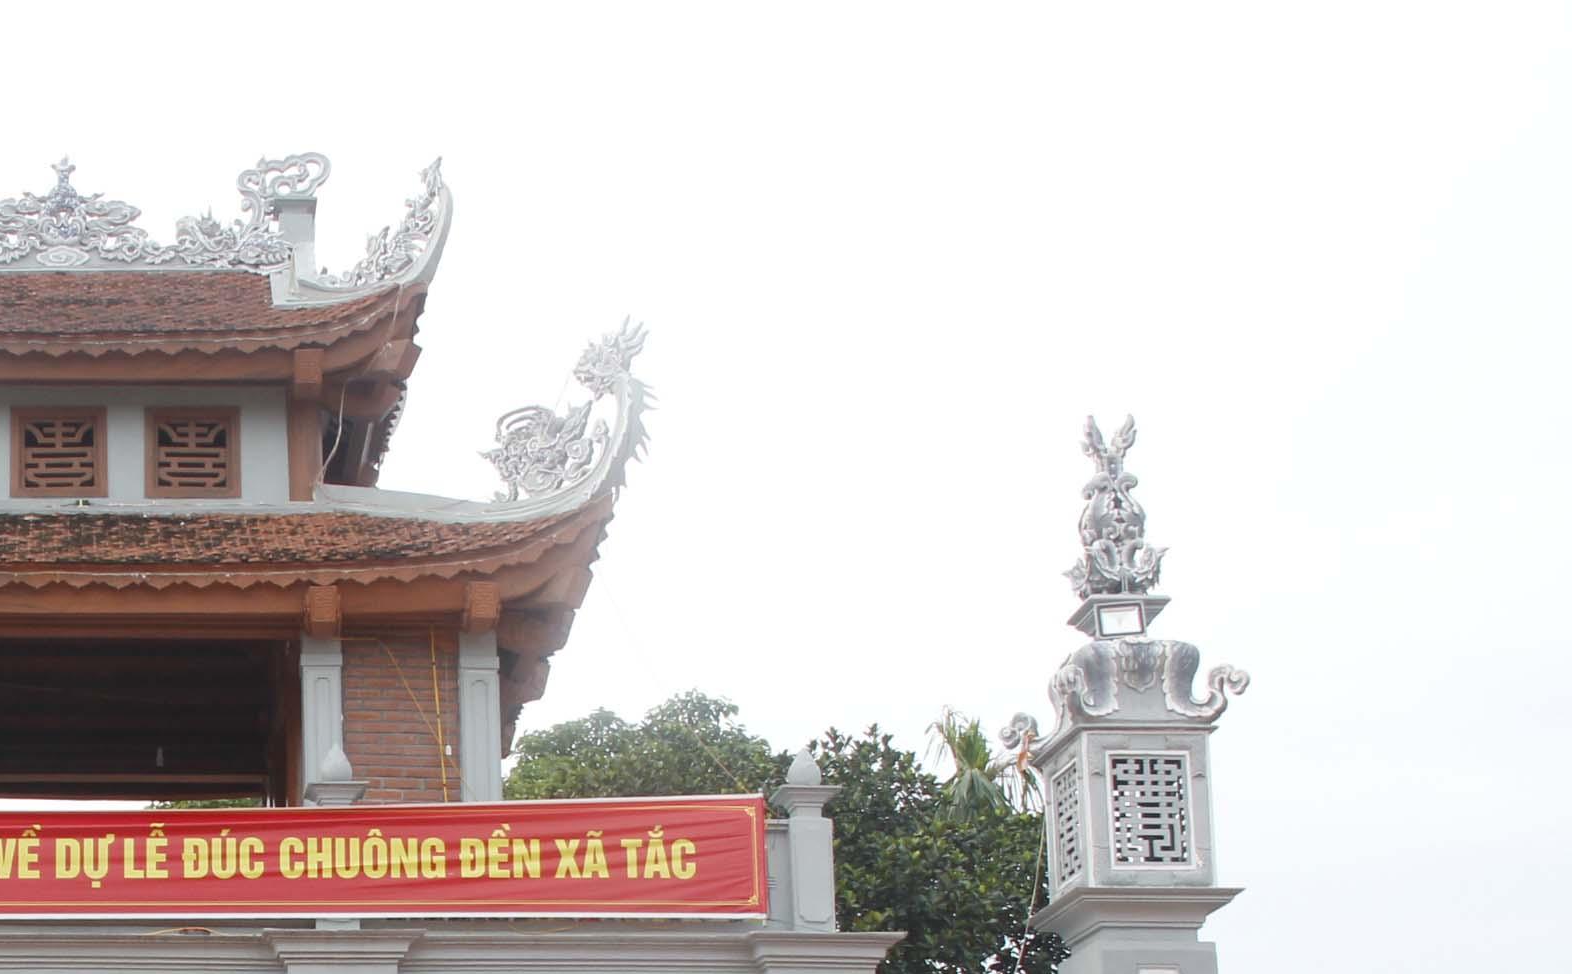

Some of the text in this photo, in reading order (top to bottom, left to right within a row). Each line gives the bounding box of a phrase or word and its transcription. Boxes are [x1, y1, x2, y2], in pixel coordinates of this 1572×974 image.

[56, 834, 115, 888] DỰ
[123, 822, 169, 879] LỄ
[182, 829, 265, 879] ĐÚC
[279, 829, 447, 879] CHUÔNG
[459, 824, 541, 879] ĐỀN
[554, 830, 609, 878] XÃ
[622, 824, 696, 879] TẮC
